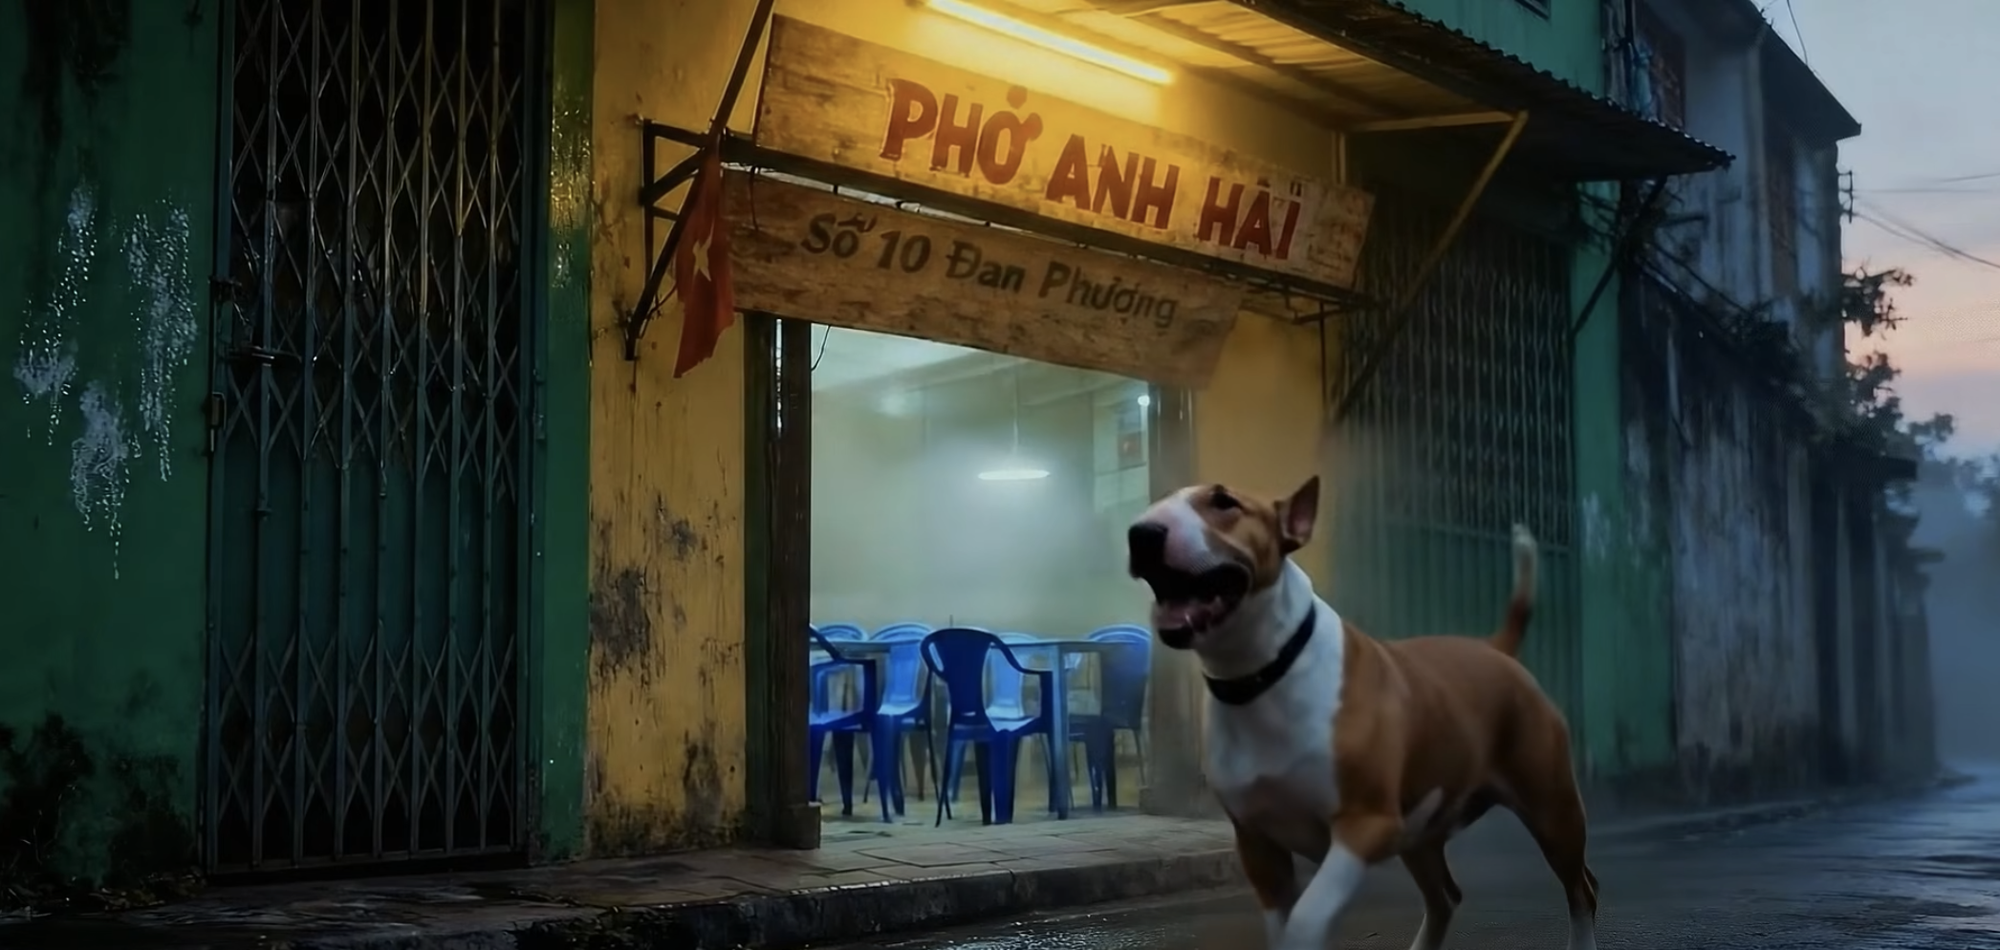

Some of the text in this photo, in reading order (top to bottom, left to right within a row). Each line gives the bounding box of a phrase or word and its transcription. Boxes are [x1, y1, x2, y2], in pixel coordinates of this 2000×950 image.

[1046, 133, 1181, 230] ANH
[800, 212, 878, 259] Số
[877, 230, 932, 274] 10
[945, 239, 1026, 293] Đan
